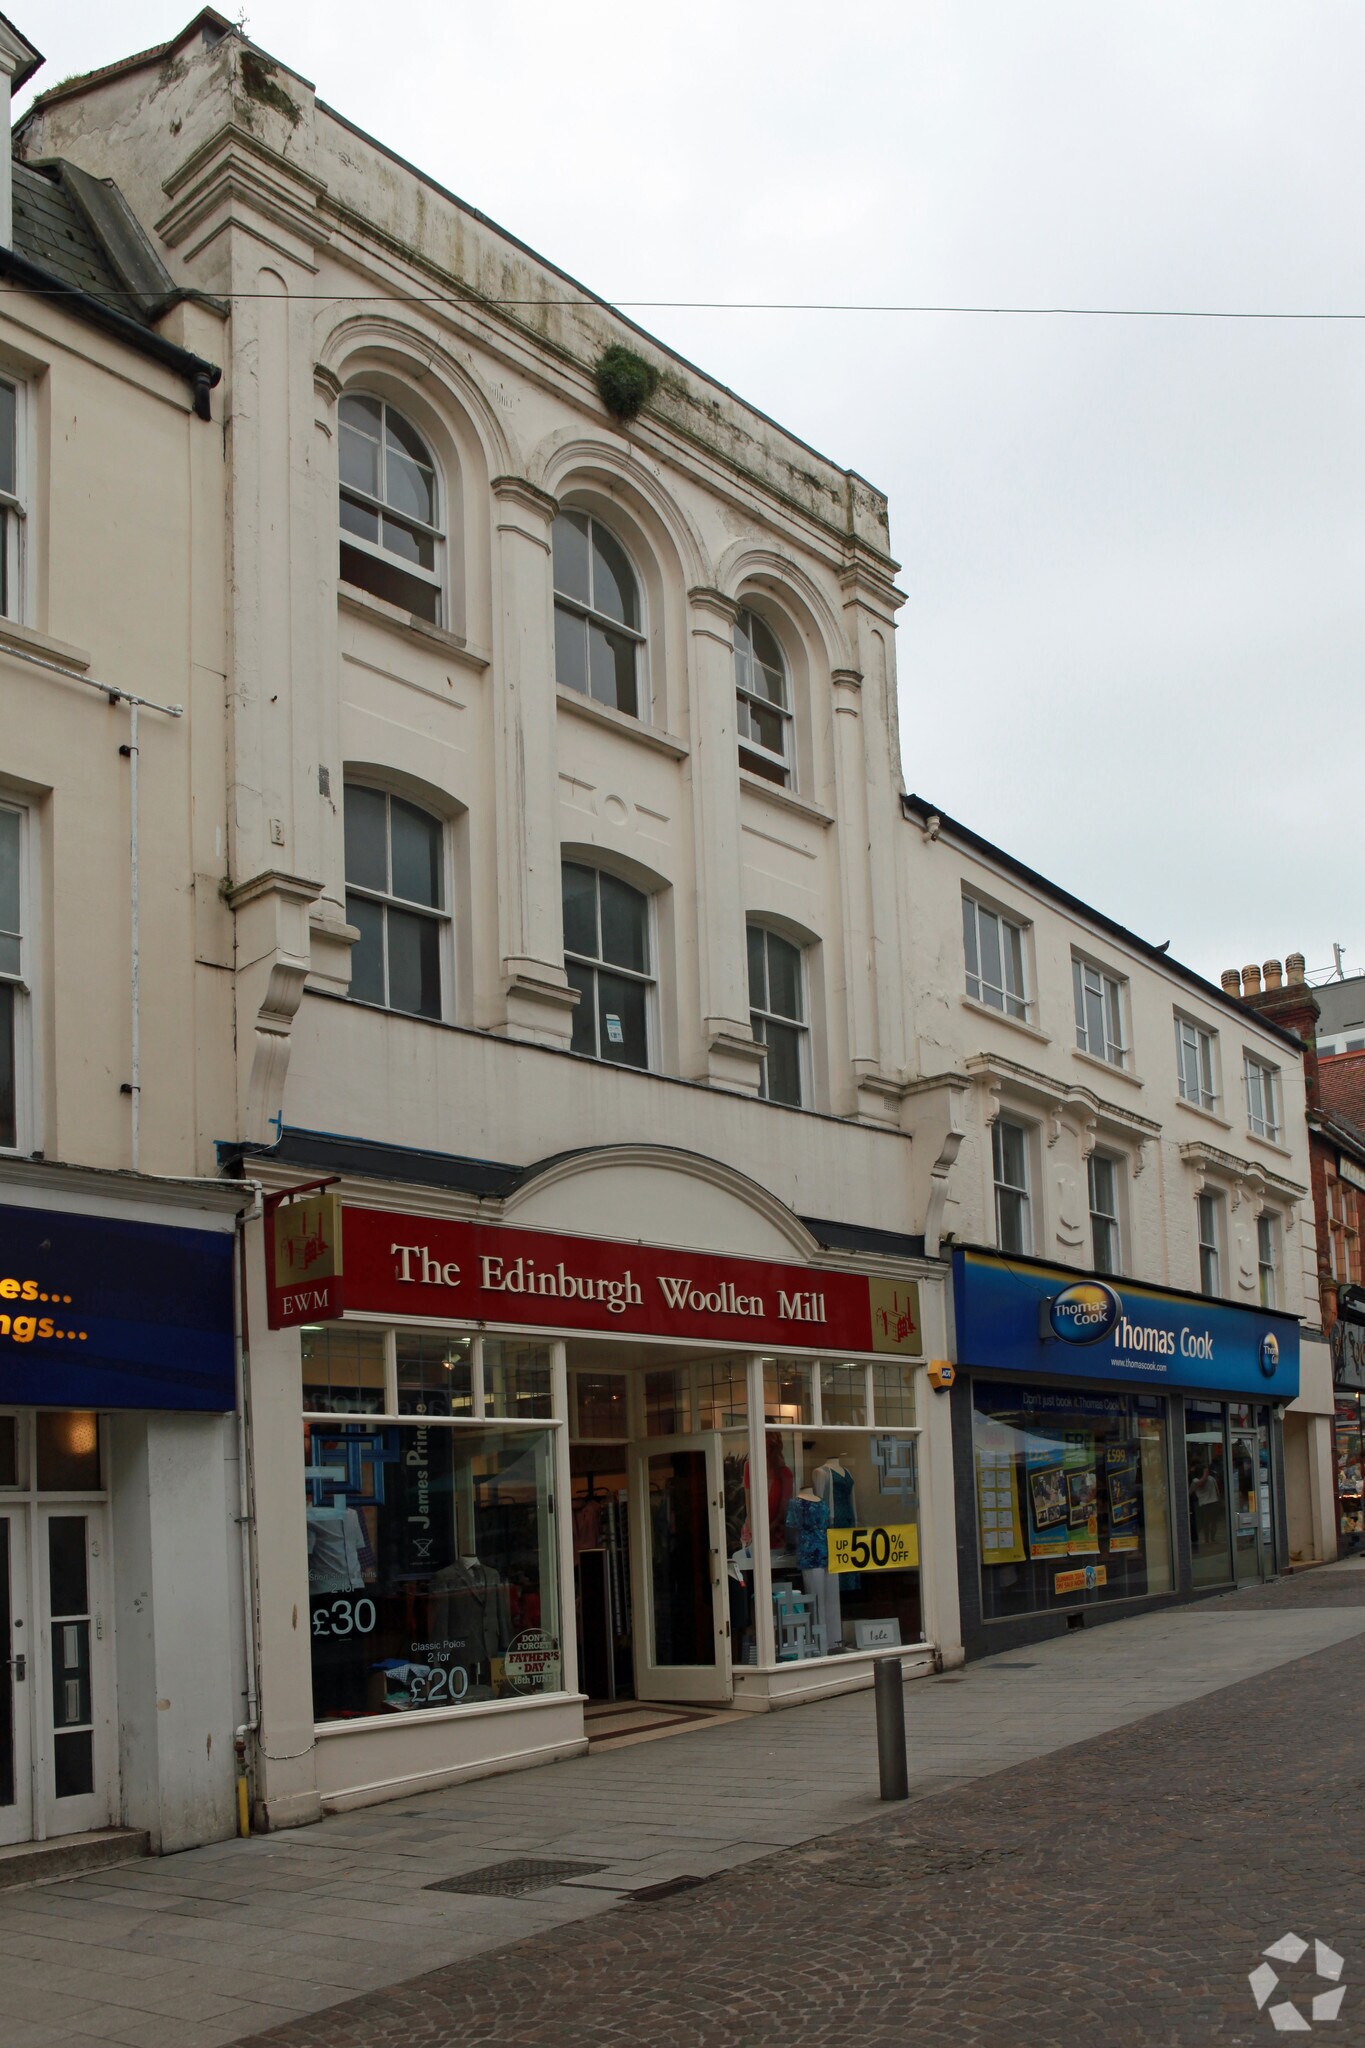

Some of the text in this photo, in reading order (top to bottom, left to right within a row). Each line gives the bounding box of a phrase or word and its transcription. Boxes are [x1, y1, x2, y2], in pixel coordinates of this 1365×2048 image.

[391, 1243, 827, 1323] The Edinburgh Woollen Mill
[282, 1289, 329, 1315] EWM
[1054, 1300, 1108, 1317] Thomas
[1073, 1312, 1108, 1326] Cook
[1180, 1327, 1213, 1361] Cook
[1111, 1358, 1167, 1372] www.thomascook.com
[1023, 1392, 1041, 1405] Don't
[1043, 1395, 1055, 1408] just
[1056, 1396, 1073, 1408] book
[1080, 1397, 1103, 1409] Thomas
[408, 1470, 431, 1530] James
[836, 1540, 848, 1550] UP
[836, 1553, 849, 1564] TO
[891, 1551, 909, 1562] OFF
[331, 1583, 338, 1594] 2
[312, 1598, 376, 1636] £30
[870, 1630, 888, 1641] Isle
[410, 1640, 466, 1652] Classic Polos
[427, 1651, 451, 1663] 2 for
[509, 1652, 559, 1664] FATHER'S
[524, 1663, 545, 1673] DAY
[410, 1666, 468, 1703] £20
